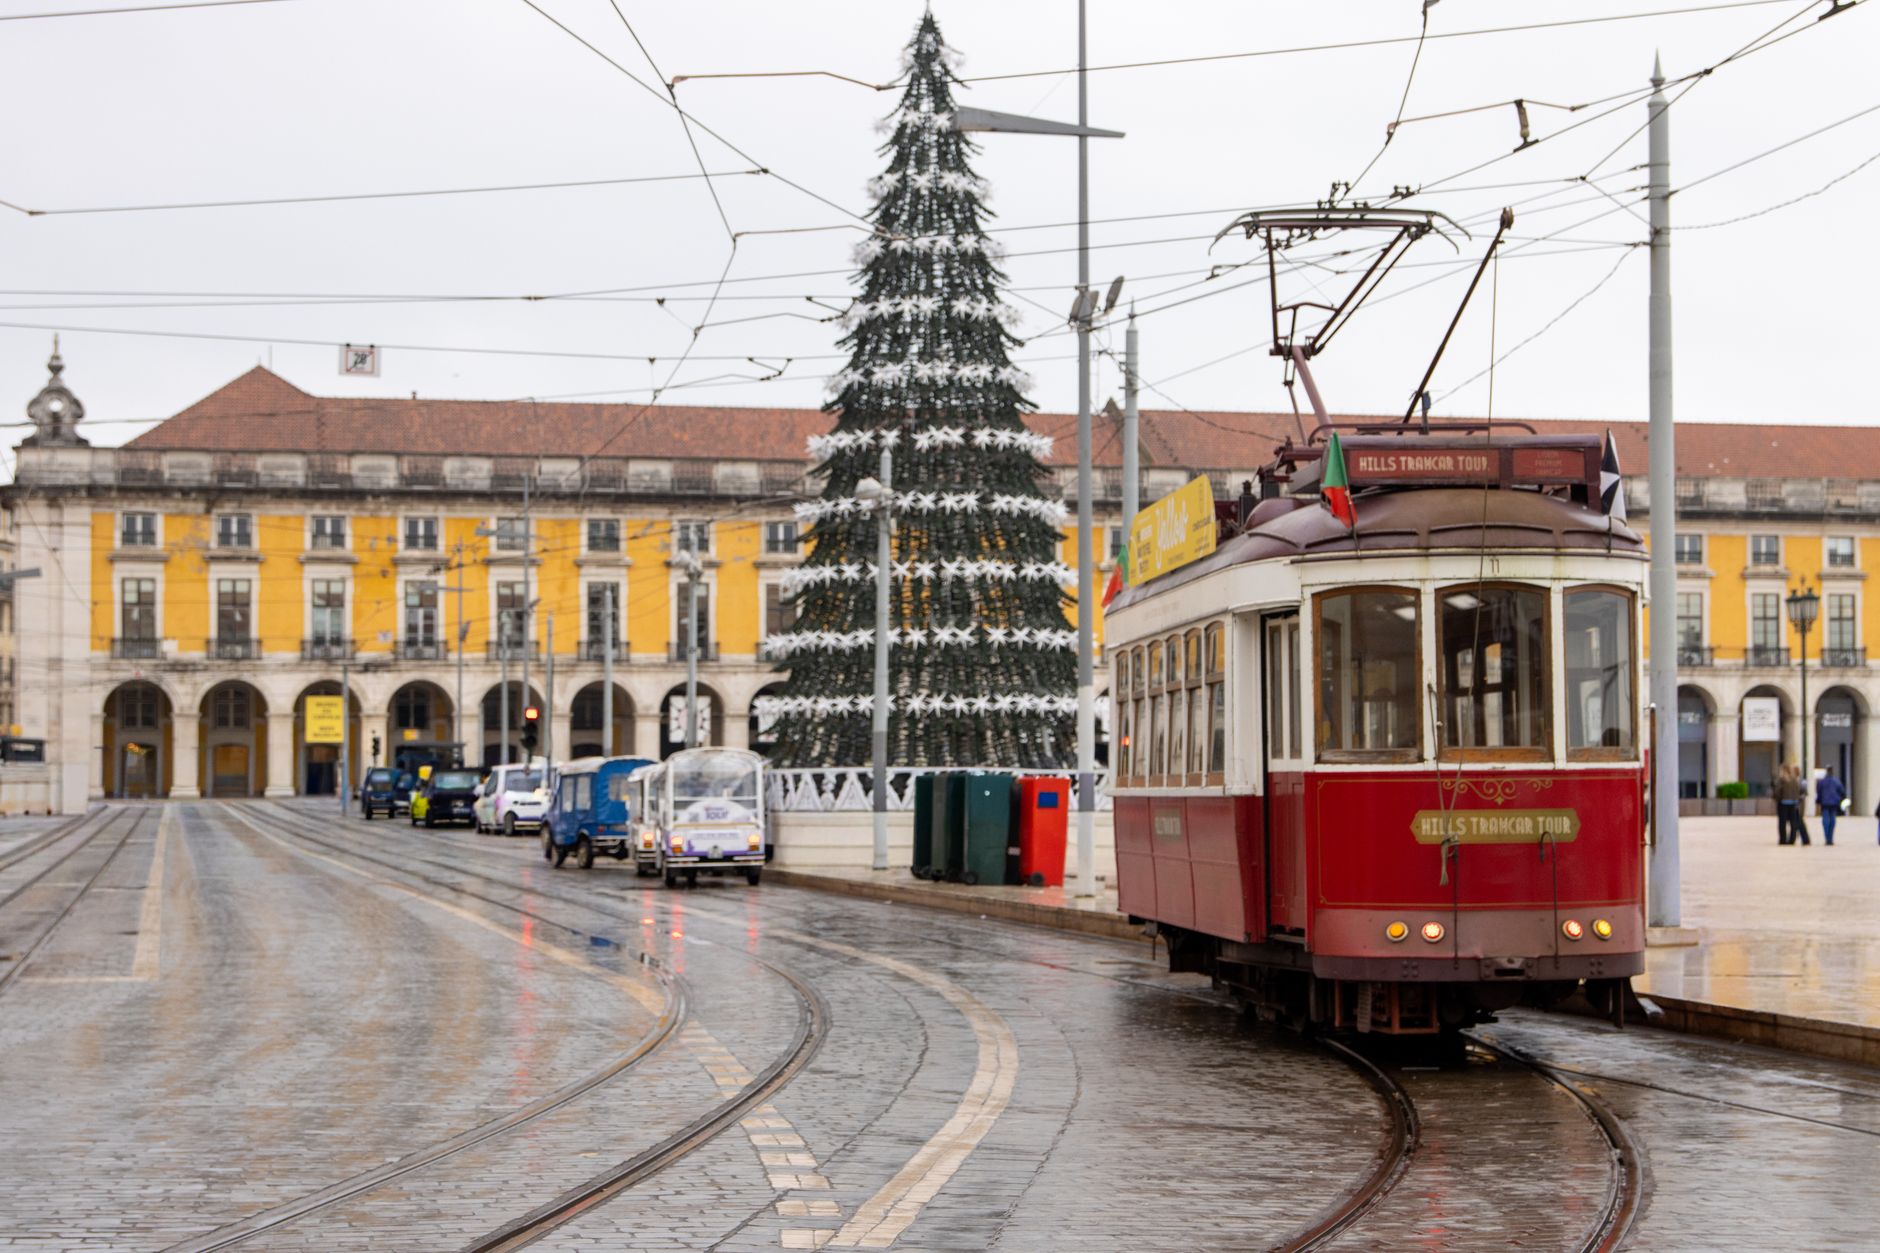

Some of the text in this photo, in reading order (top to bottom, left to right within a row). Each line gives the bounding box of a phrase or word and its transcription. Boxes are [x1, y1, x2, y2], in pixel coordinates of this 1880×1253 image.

[1359, 455, 1490, 472] HILLS TRAMCAR TOUR
[1421, 816, 1571, 835] HILLS TRAMCAR TOUR
